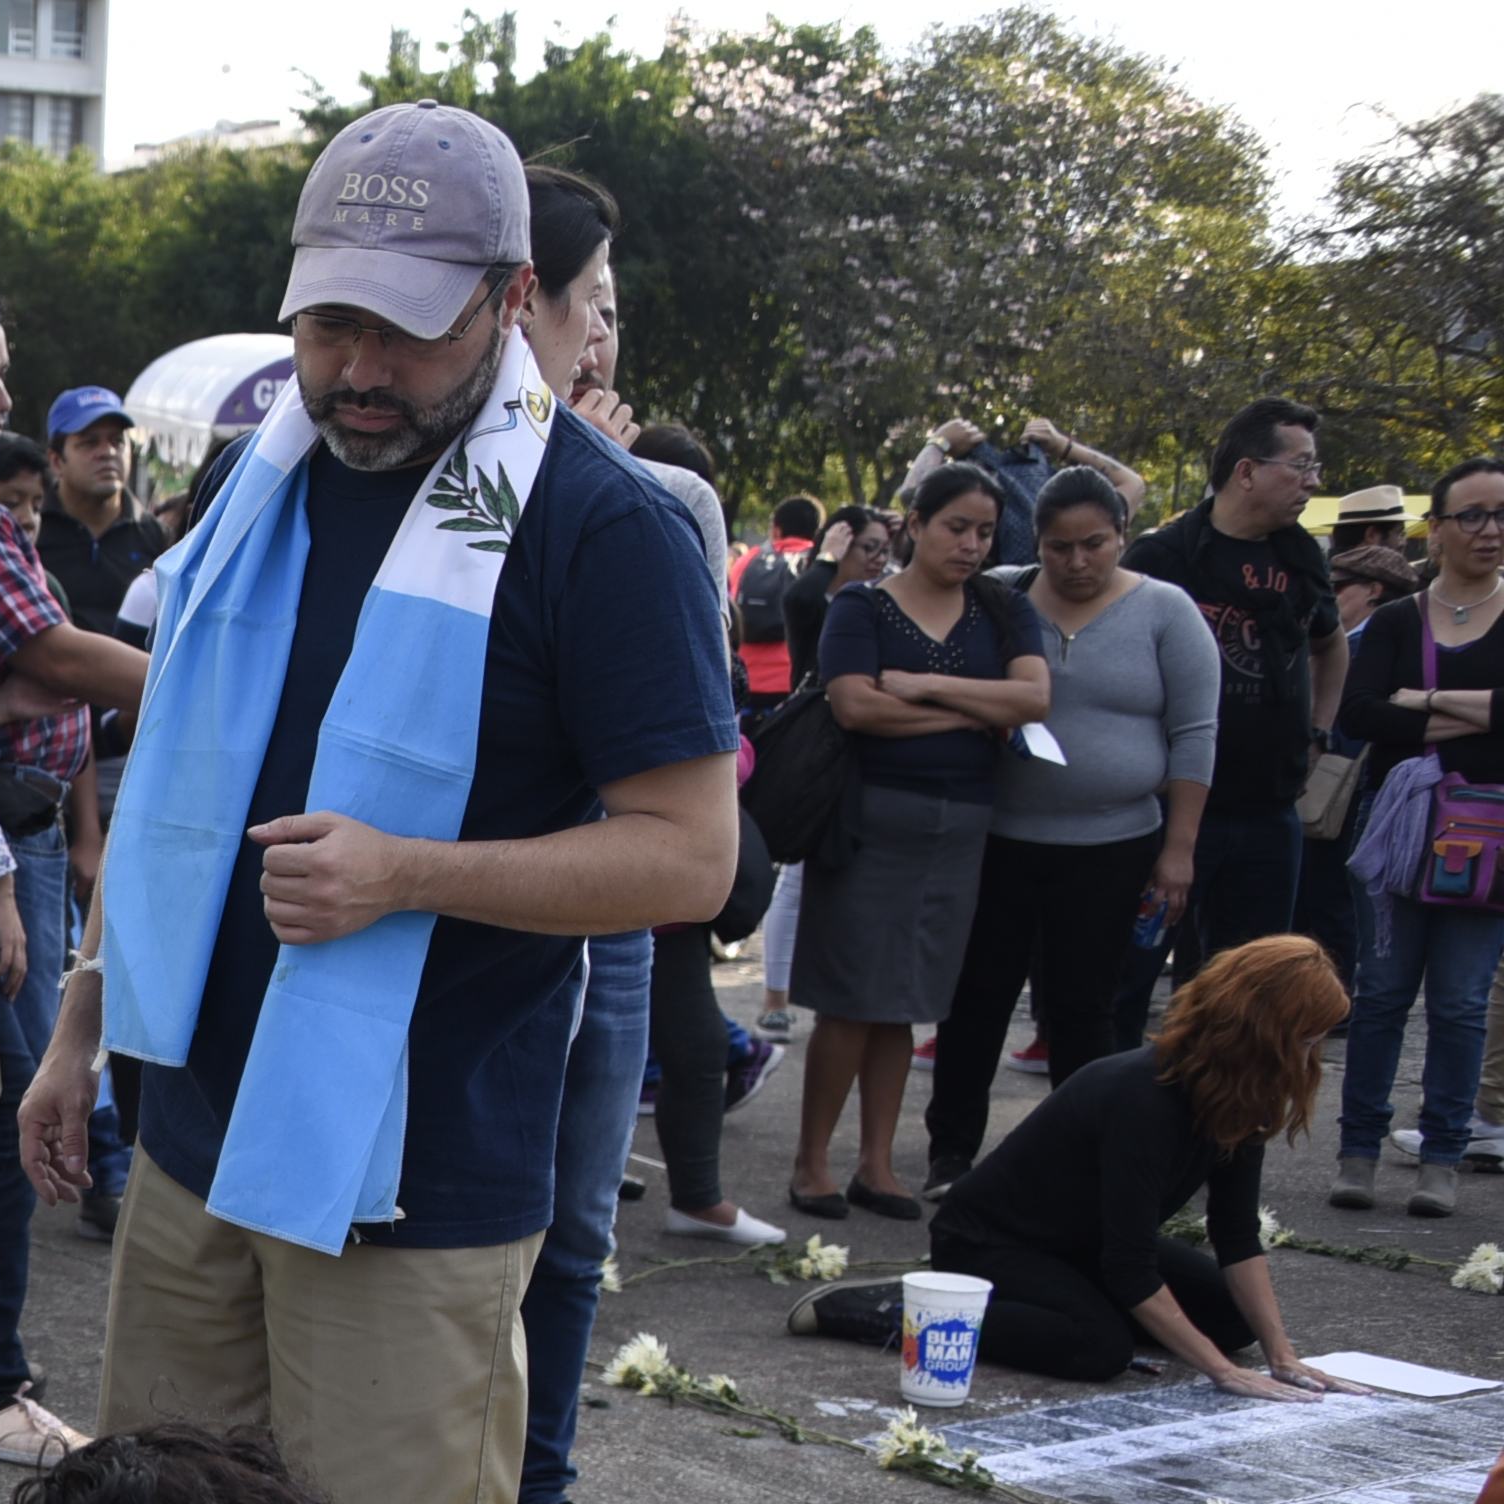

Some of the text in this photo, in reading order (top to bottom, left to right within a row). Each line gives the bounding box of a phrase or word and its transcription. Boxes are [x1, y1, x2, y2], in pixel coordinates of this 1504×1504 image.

[338, 172, 431, 207] BOSS
[332, 208, 425, 231] MARE
[926, 1329, 974, 1346] BLUE
[925, 1345, 973, 1361] MAN
[924, 1361, 969, 1372] GROUP
